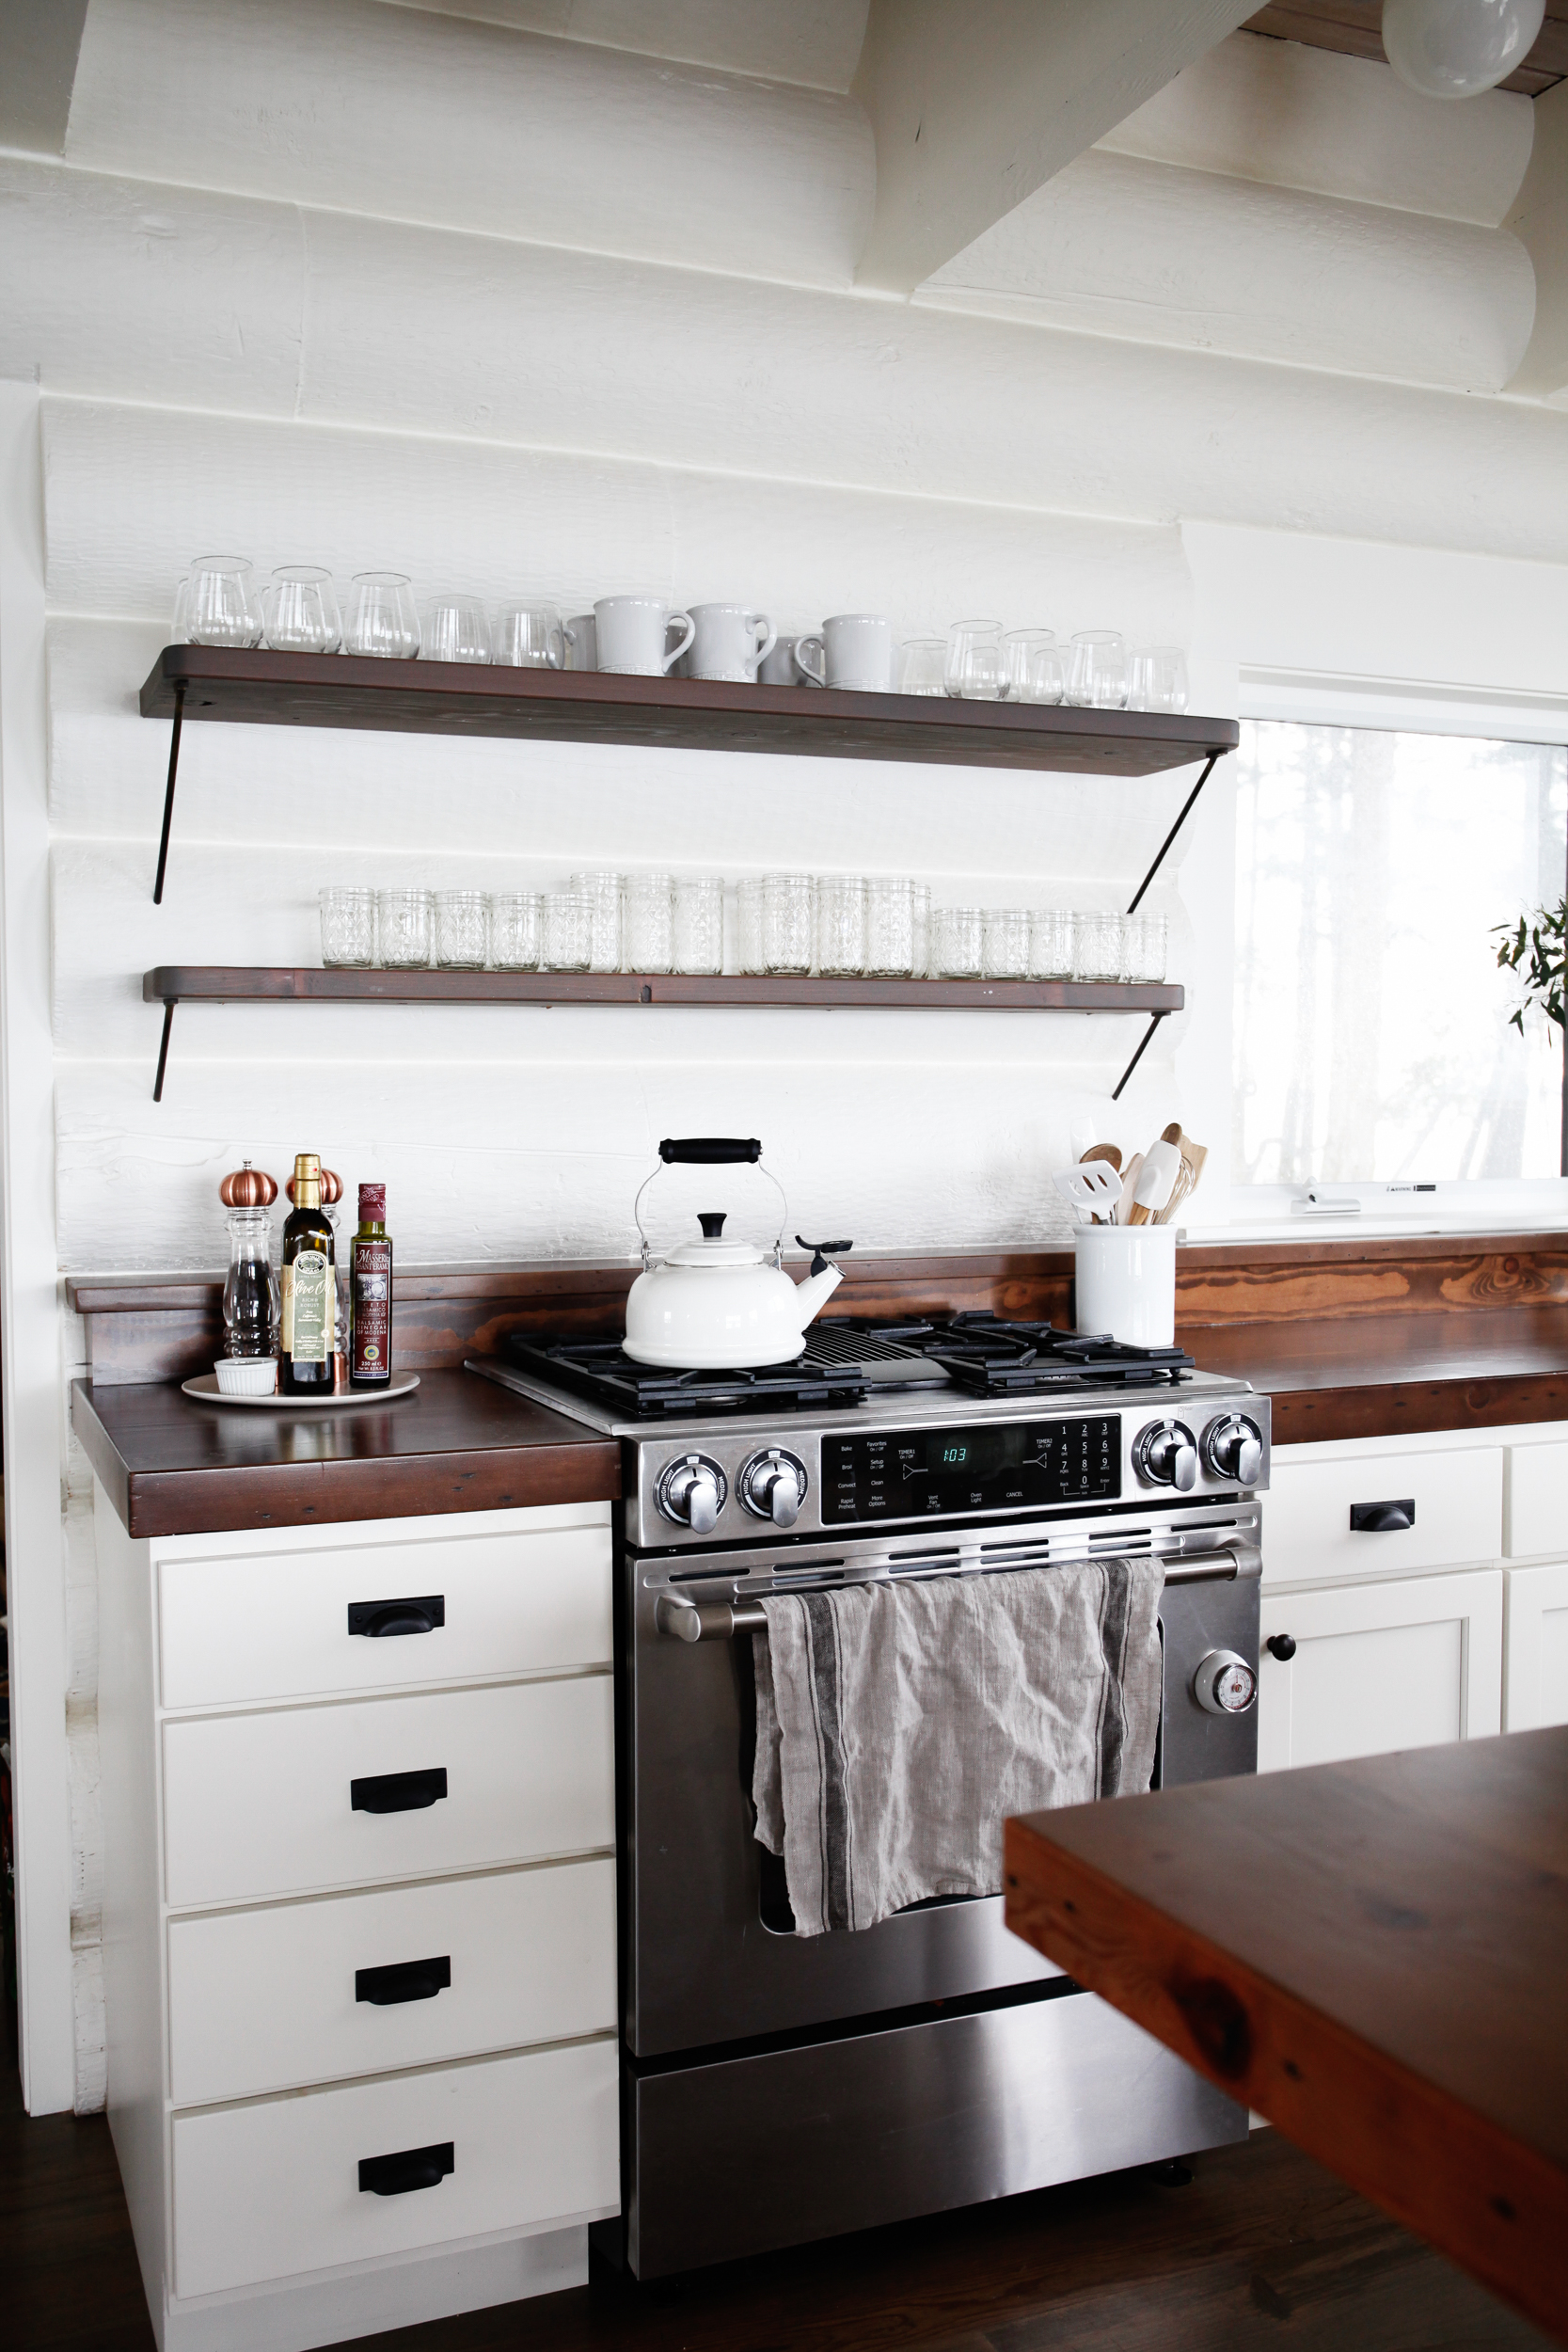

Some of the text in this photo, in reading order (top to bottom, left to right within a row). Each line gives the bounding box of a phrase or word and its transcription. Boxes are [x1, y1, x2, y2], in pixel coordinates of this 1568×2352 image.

[285, 1279, 334, 1298] Olive Oil
[1062, 1426, 1066, 1434] 1
[1082, 1424, 1087, 1432] 2
[1102, 1423, 1107, 1431] 3
[1211, 1426, 1220, 1441] LIGHT
[1145, 1432, 1153, 1447] LIGHT
[1082, 1442, 1087, 1450] 5
[1102, 1440, 1107, 1448] 6
[1062, 1461, 1067, 1469] 7
[1082, 1459, 1087, 1467] 8
[1102, 1458, 1107, 1466] 9
[745, 1463, 755, 1480] LIGHT
[663, 1469, 674, 1485] LIGHT
[1082, 1476, 1087, 1484] 0
